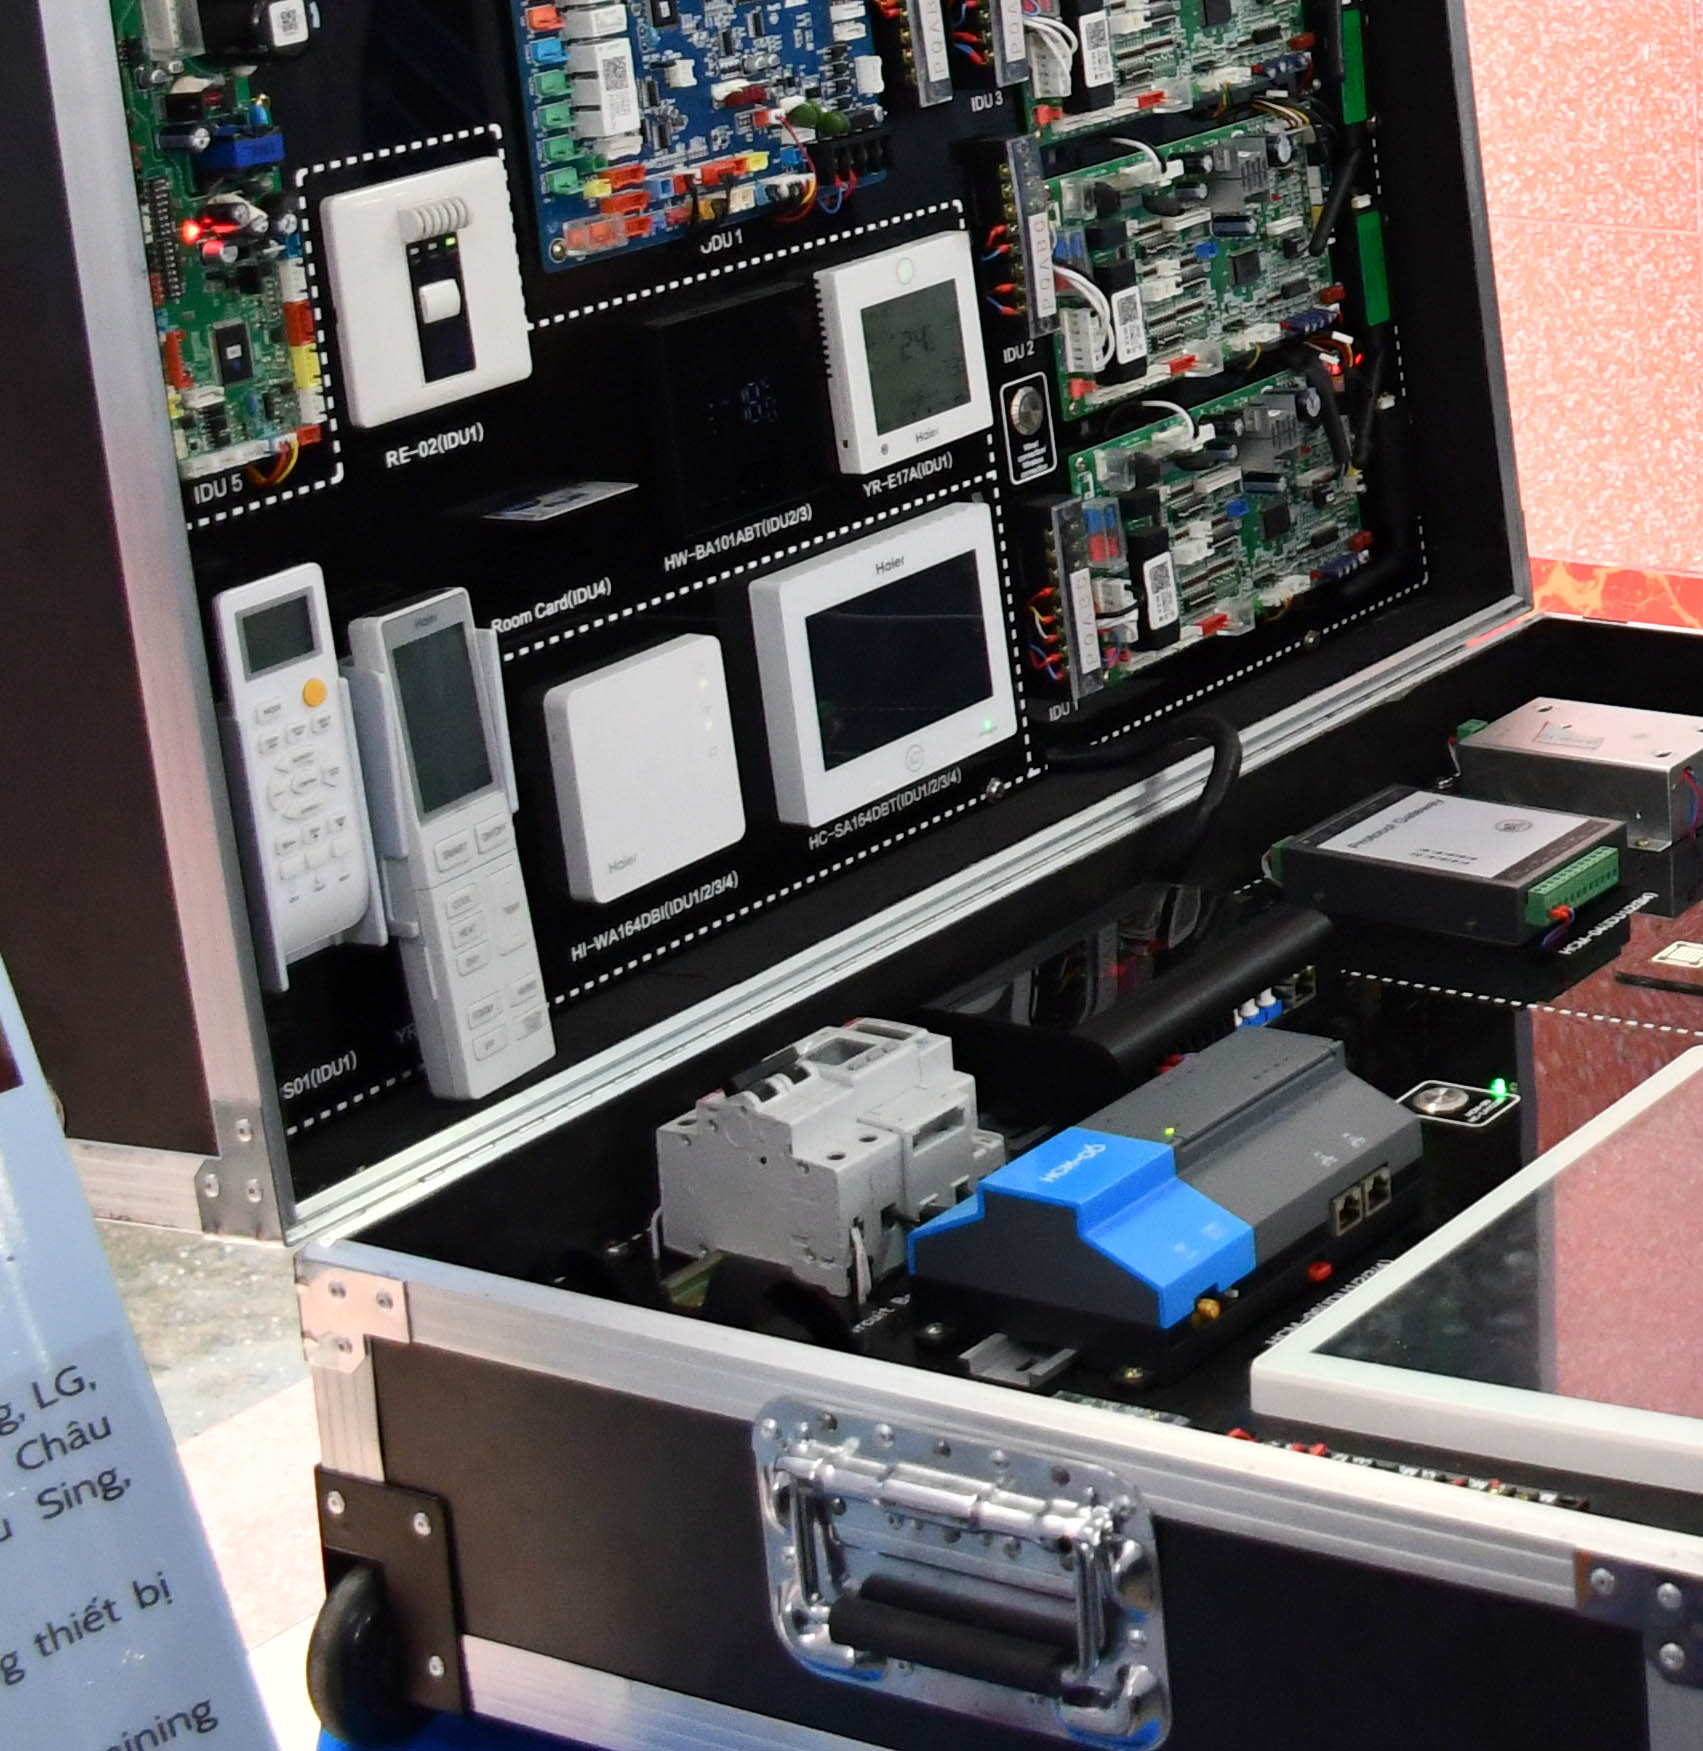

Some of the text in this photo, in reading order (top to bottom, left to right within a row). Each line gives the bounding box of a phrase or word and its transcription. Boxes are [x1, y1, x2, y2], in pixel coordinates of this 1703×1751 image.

[971, 91, 1004, 112] IDU 3
[735, 228, 743, 244] 1
[1003, 340, 1035, 364] IDU 2
[385, 422, 485, 469] RE-02(IDU1)
[193, 473, 243, 505] IDU 5
[862, 451, 953, 498] YR-E17A(IDU1)
[491, 576, 613, 635] Room Card(IDU4)
[281, 1050, 358, 1100] S01(IDU1)
[32, 1365, 97, 1410] LG,
[16, 1416, 112, 1470] Châu
[36, 1467, 131, 1520] Sing,
[34, 1596, 122, 1657] thiết
[132, 1570, 173, 1610] bị
[107, 1699, 219, 1751] ining
